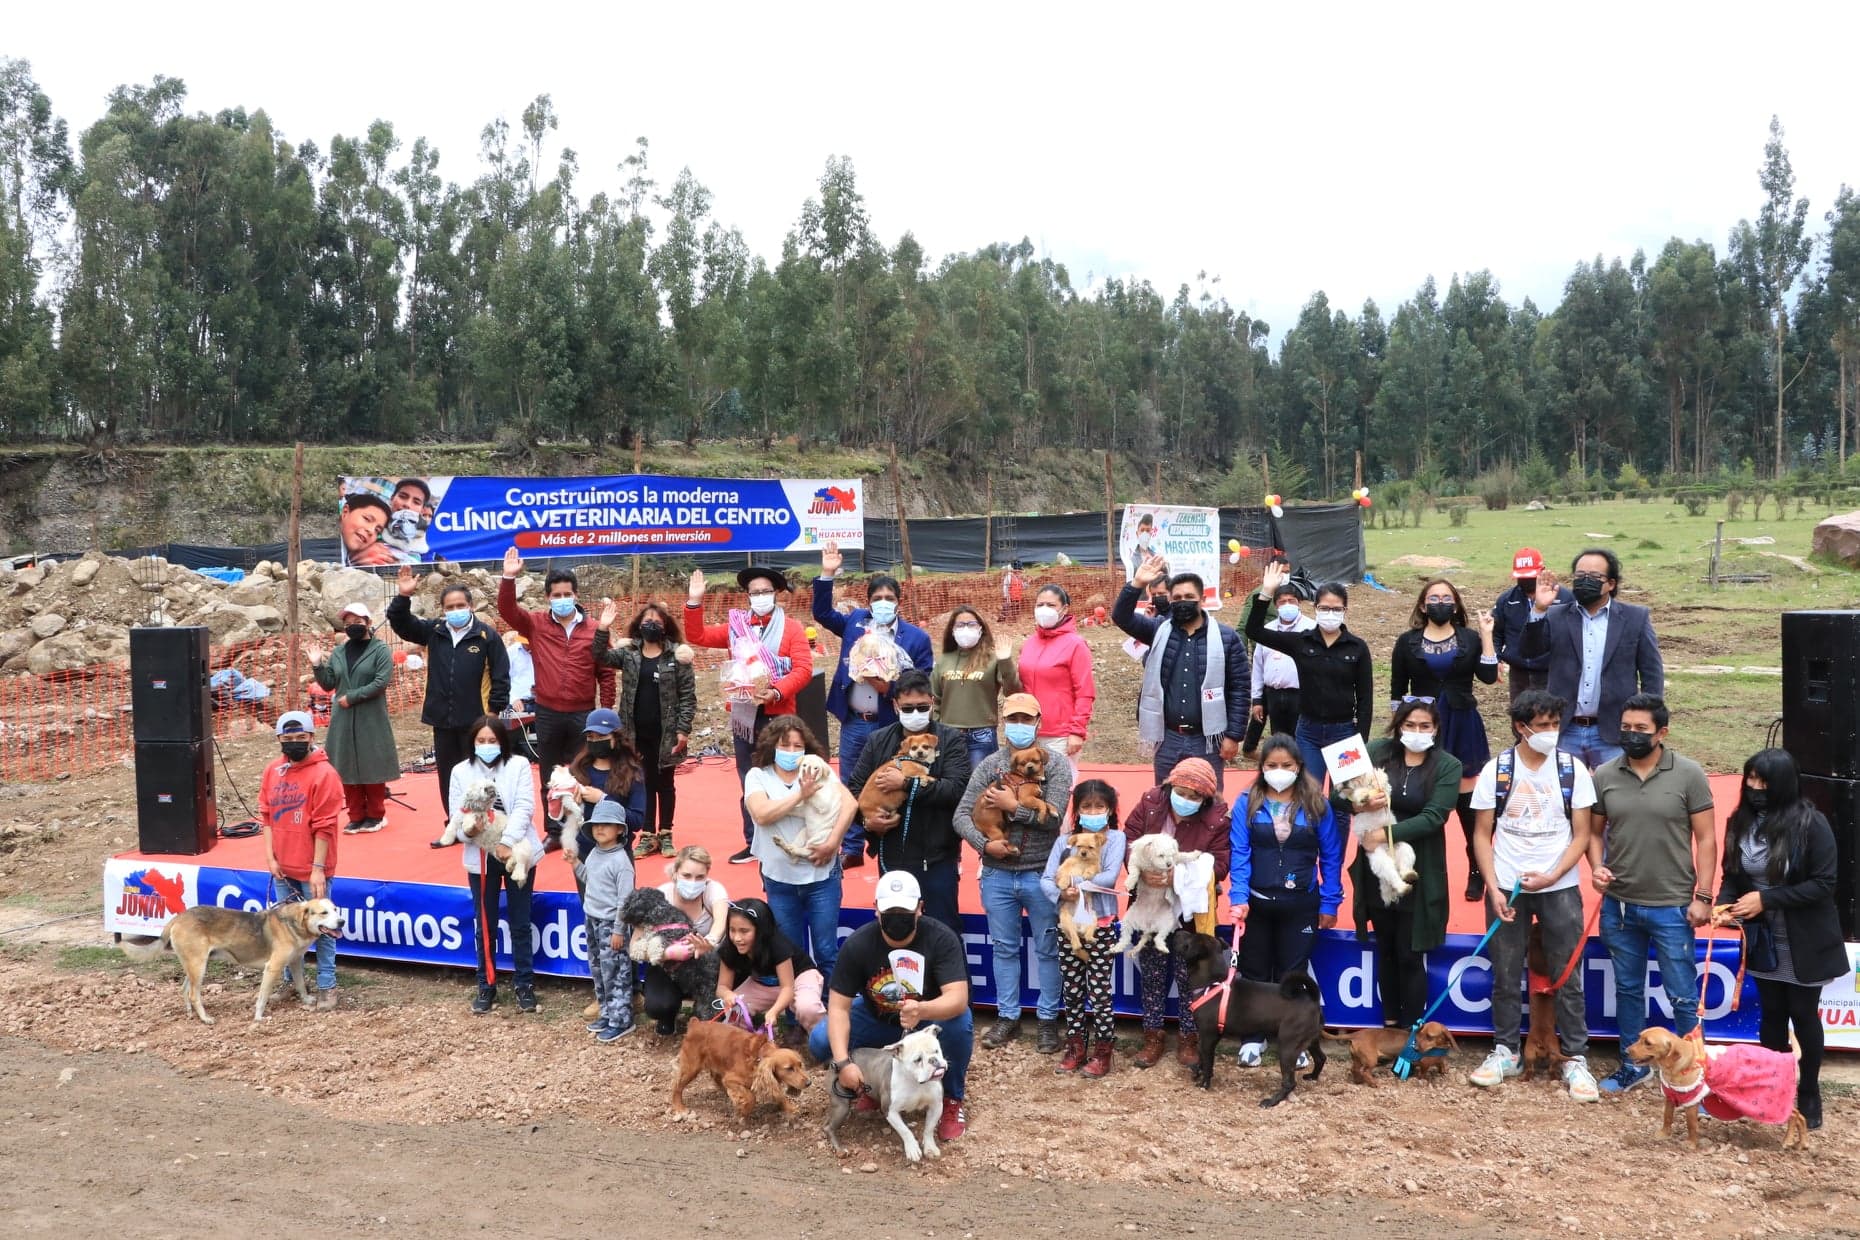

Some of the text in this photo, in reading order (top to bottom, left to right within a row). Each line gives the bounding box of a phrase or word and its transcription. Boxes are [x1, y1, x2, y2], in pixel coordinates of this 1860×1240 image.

[505, 486, 739, 506] Construimos la moderna
[434, 507, 790, 532] CLÍNICA VETERINARIA DEL CENTRO
[540, 530, 711, 546] Más de 2 millones en inversión
[818, 530, 863, 539] HUANCAYO
[1165, 540, 1214, 554] MASCOTAS
